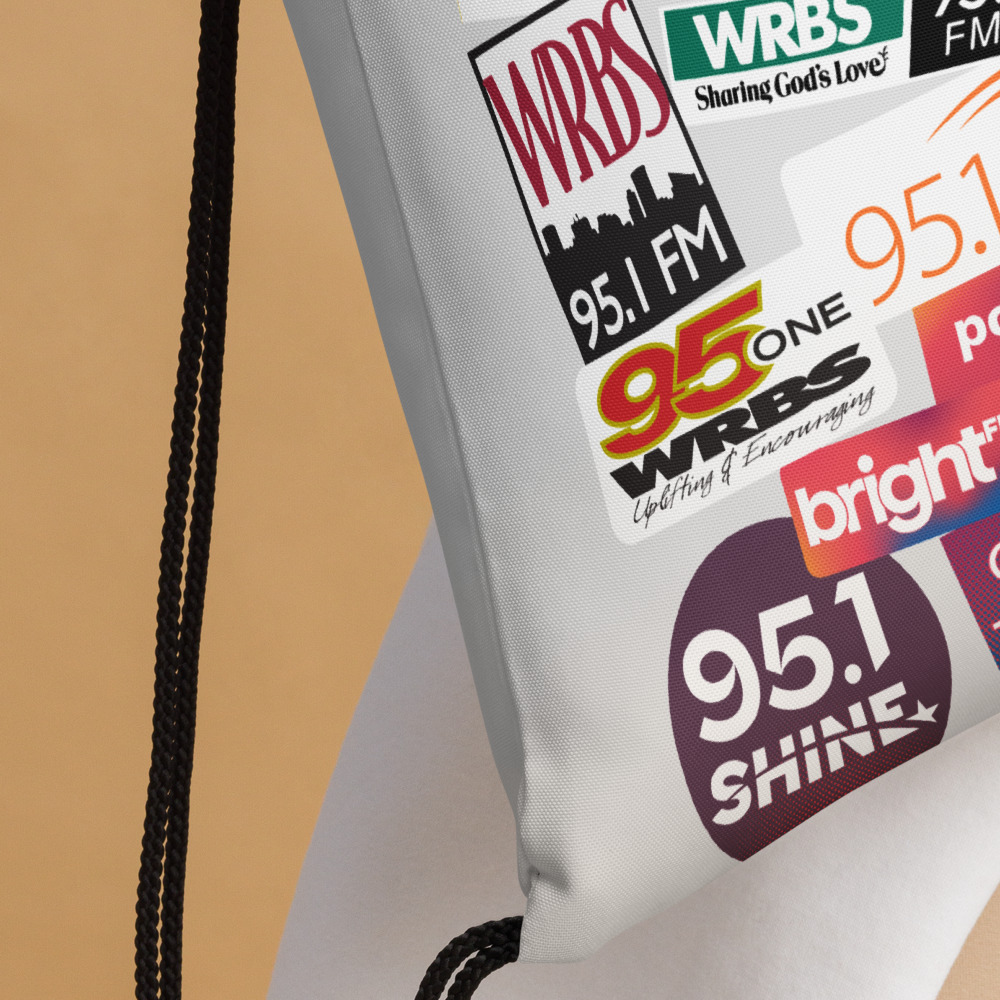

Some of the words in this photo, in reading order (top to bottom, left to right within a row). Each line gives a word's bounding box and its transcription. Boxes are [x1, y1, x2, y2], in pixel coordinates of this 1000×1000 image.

[695, 79, 773, 111] Sharing
[774, 63, 832, 97] God's
[835, 46, 889, 84] Love
[944, 11, 1000, 56] FM
[570, 257, 650, 350] 95.1
[650, 204, 728, 295] FM
[597, 279, 774, 460] 95
[753, 291, 852, 363] ONE
[609, 343, 872, 499] WRBS
[633, 470, 714, 529] Uplifting
[742, 386, 875, 469] Encouraging
[682, 571, 890, 743] 95.1
[710, 681, 920, 826] SHINE
